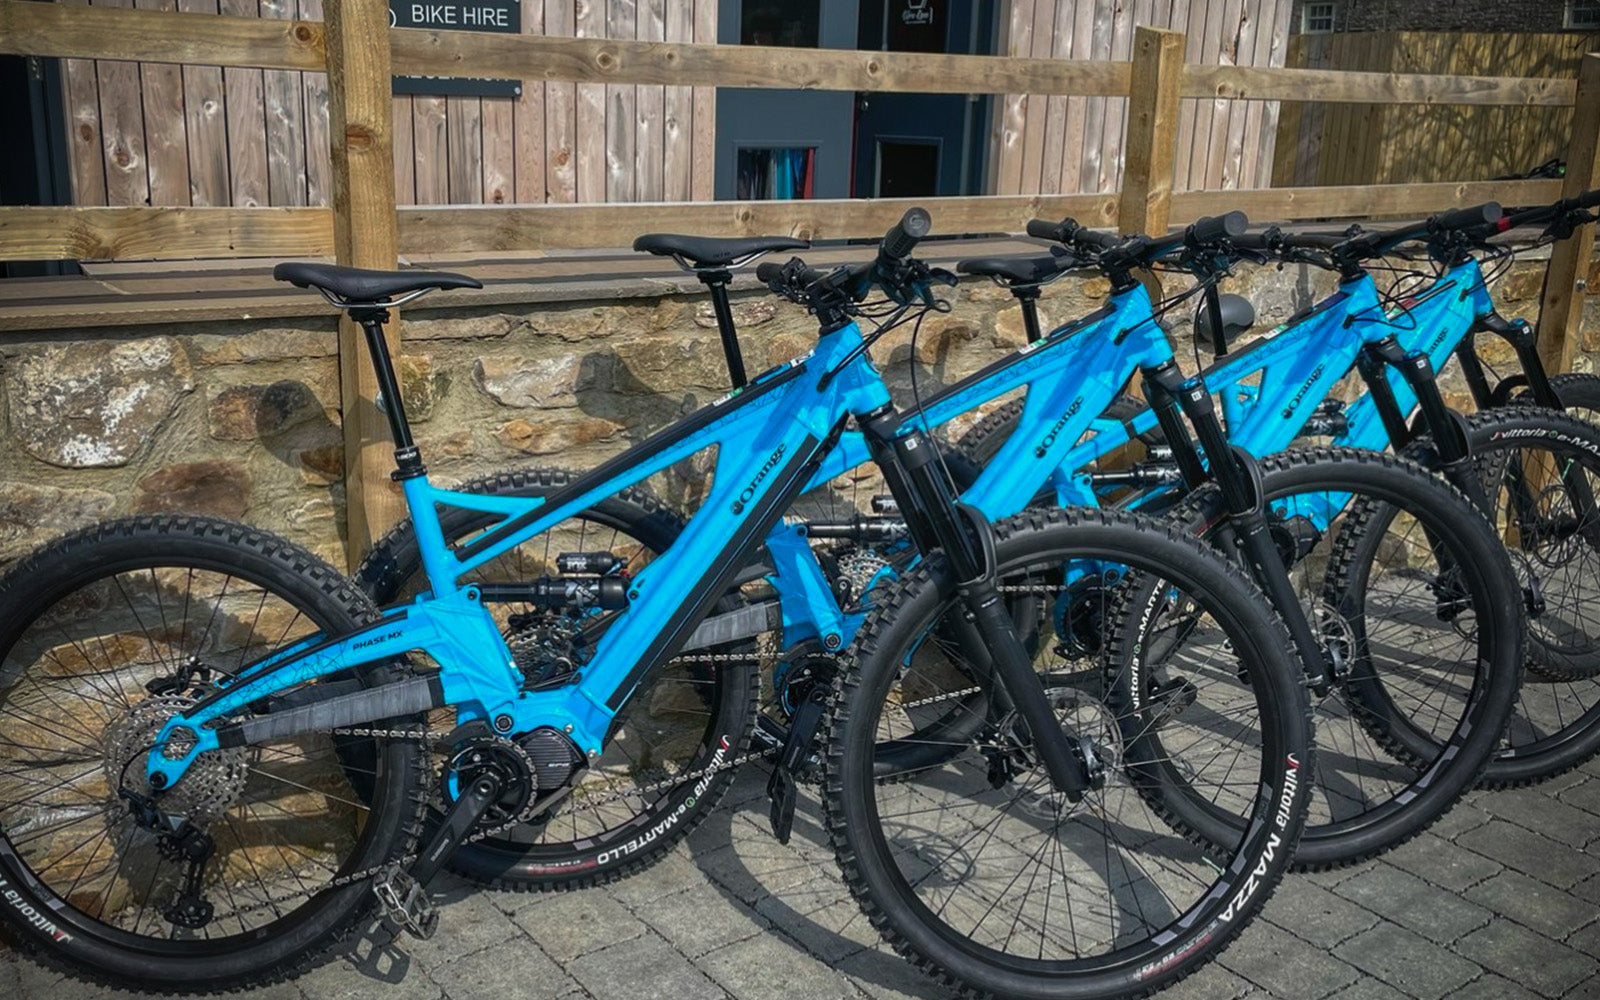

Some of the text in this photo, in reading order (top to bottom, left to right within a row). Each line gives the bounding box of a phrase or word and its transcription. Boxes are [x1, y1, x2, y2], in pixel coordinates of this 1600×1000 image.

[411, 4, 509, 27] BIKE HIRE
[1289, 363, 1325, 410] Orange
[1042, 396, 1084, 448] Orange
[740, 443, 787, 504] Orange
[353, 630, 403, 650] PHASE MX
[1218, 832, 1282, 922] MAZZA
